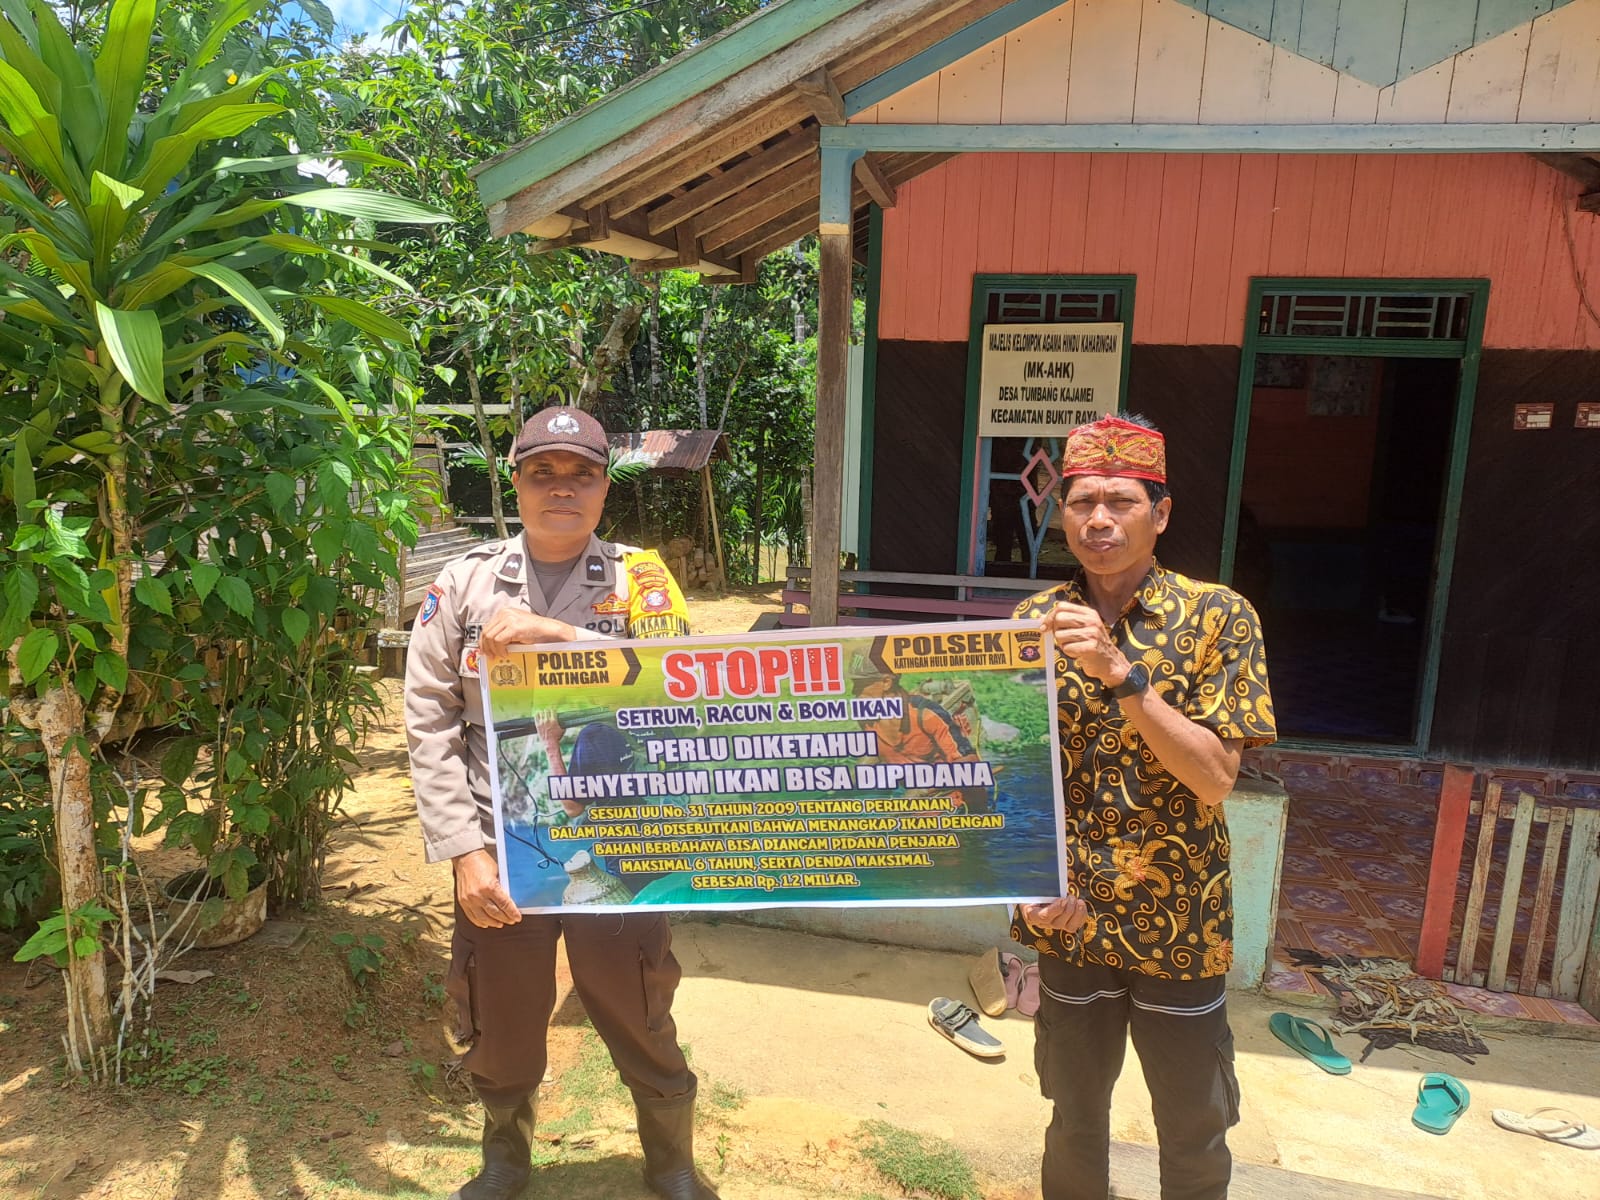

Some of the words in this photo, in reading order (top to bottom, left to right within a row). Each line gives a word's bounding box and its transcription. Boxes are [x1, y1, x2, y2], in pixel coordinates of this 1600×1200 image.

[989, 333, 1011, 351] MAJELIS
[1012, 334, 1042, 352] KELOMPOK
[1042, 334, 1061, 352] AGAMA
[1062, 335, 1080, 352] HINDU
[1081, 335, 1117, 353] KAHARINGAN
[1023, 361, 1075, 383] (MK-AHK)
[999, 386, 1019, 401] DESA
[1020, 387, 1058, 402] TUMBANG
[1060, 388, 1094, 402] KAJAMEI
[991, 409, 1045, 424] KECAMATAN
[1046, 410, 1073, 424] BUKIT
[893, 632, 1004, 657] POLSEK
[537, 651, 608, 670] POLRES
[894, 656, 929, 670] KATINGAN
[930, 655, 948, 668] HULU
[949, 655, 965, 667] DAN
[965, 653, 987, 667] BUKIT
[988, 652, 1007, 666] RAYA
[538, 671, 609, 686] KATINGAN
[664, 645, 842, 699] STOP!!!
[618, 707, 701, 728] SETRUM,
[707, 704, 772, 724] RACUN
[777, 704, 794, 721] &
[799, 701, 847, 720] BOM
[852, 699, 902, 718] IKAN
[647, 736, 728, 764] PERLU
[733, 731, 877, 762] DIKETAHUI
[548, 771, 710, 800] MENYETRUM
[713, 767, 780, 794] IKAN
[785, 766, 851, 792] BISA
[855, 762, 994, 791] DIPIDANA
[589, 806, 639, 821] SESUAI
[640, 805, 661, 819] UU
[663, 804, 687, 819] No.
[688, 804, 705, 817] 31
[706, 803, 753, 817] TAHUN
[755, 802, 795, 816] 2009
[798, 800, 862, 814] TENTANG
[865, 798, 955, 813] PERIKANAN,
[550, 826, 596, 840] DALAM
[598, 825, 640, 839] PASAL
[643, 824, 661, 837] 84
[663, 821, 750, 836] DISEBUTKAN
[752, 820, 806, 834] BAHWA
[808, 818, 897, 833] MENANGKAP
[900, 817, 937, 831] IKAN
[941, 815, 1004, 830] DENGAN
[593, 842, 642, 856] BAHAN
[644, 840, 725, 854] BERBAHAYA
[727, 838, 760, 852] BISA
[763, 837, 829, 851] DIANCAM
[831, 836, 887, 850] PIDANA
[888, 834, 959, 848] PENJARA
[620, 858, 692, 873] MAKSIMAL
[694, 858, 706, 871] 6
[707, 856, 758, 872] TAHUN,
[760, 855, 802, 869] SERTA
[804, 855, 854, 869] DENDA
[856, 853, 933, 868] MAKSIMAL
[691, 875, 753, 889] SEBESAR
[756, 874, 779, 890] Rp.
[803, 873, 860, 887] MILIAR.
